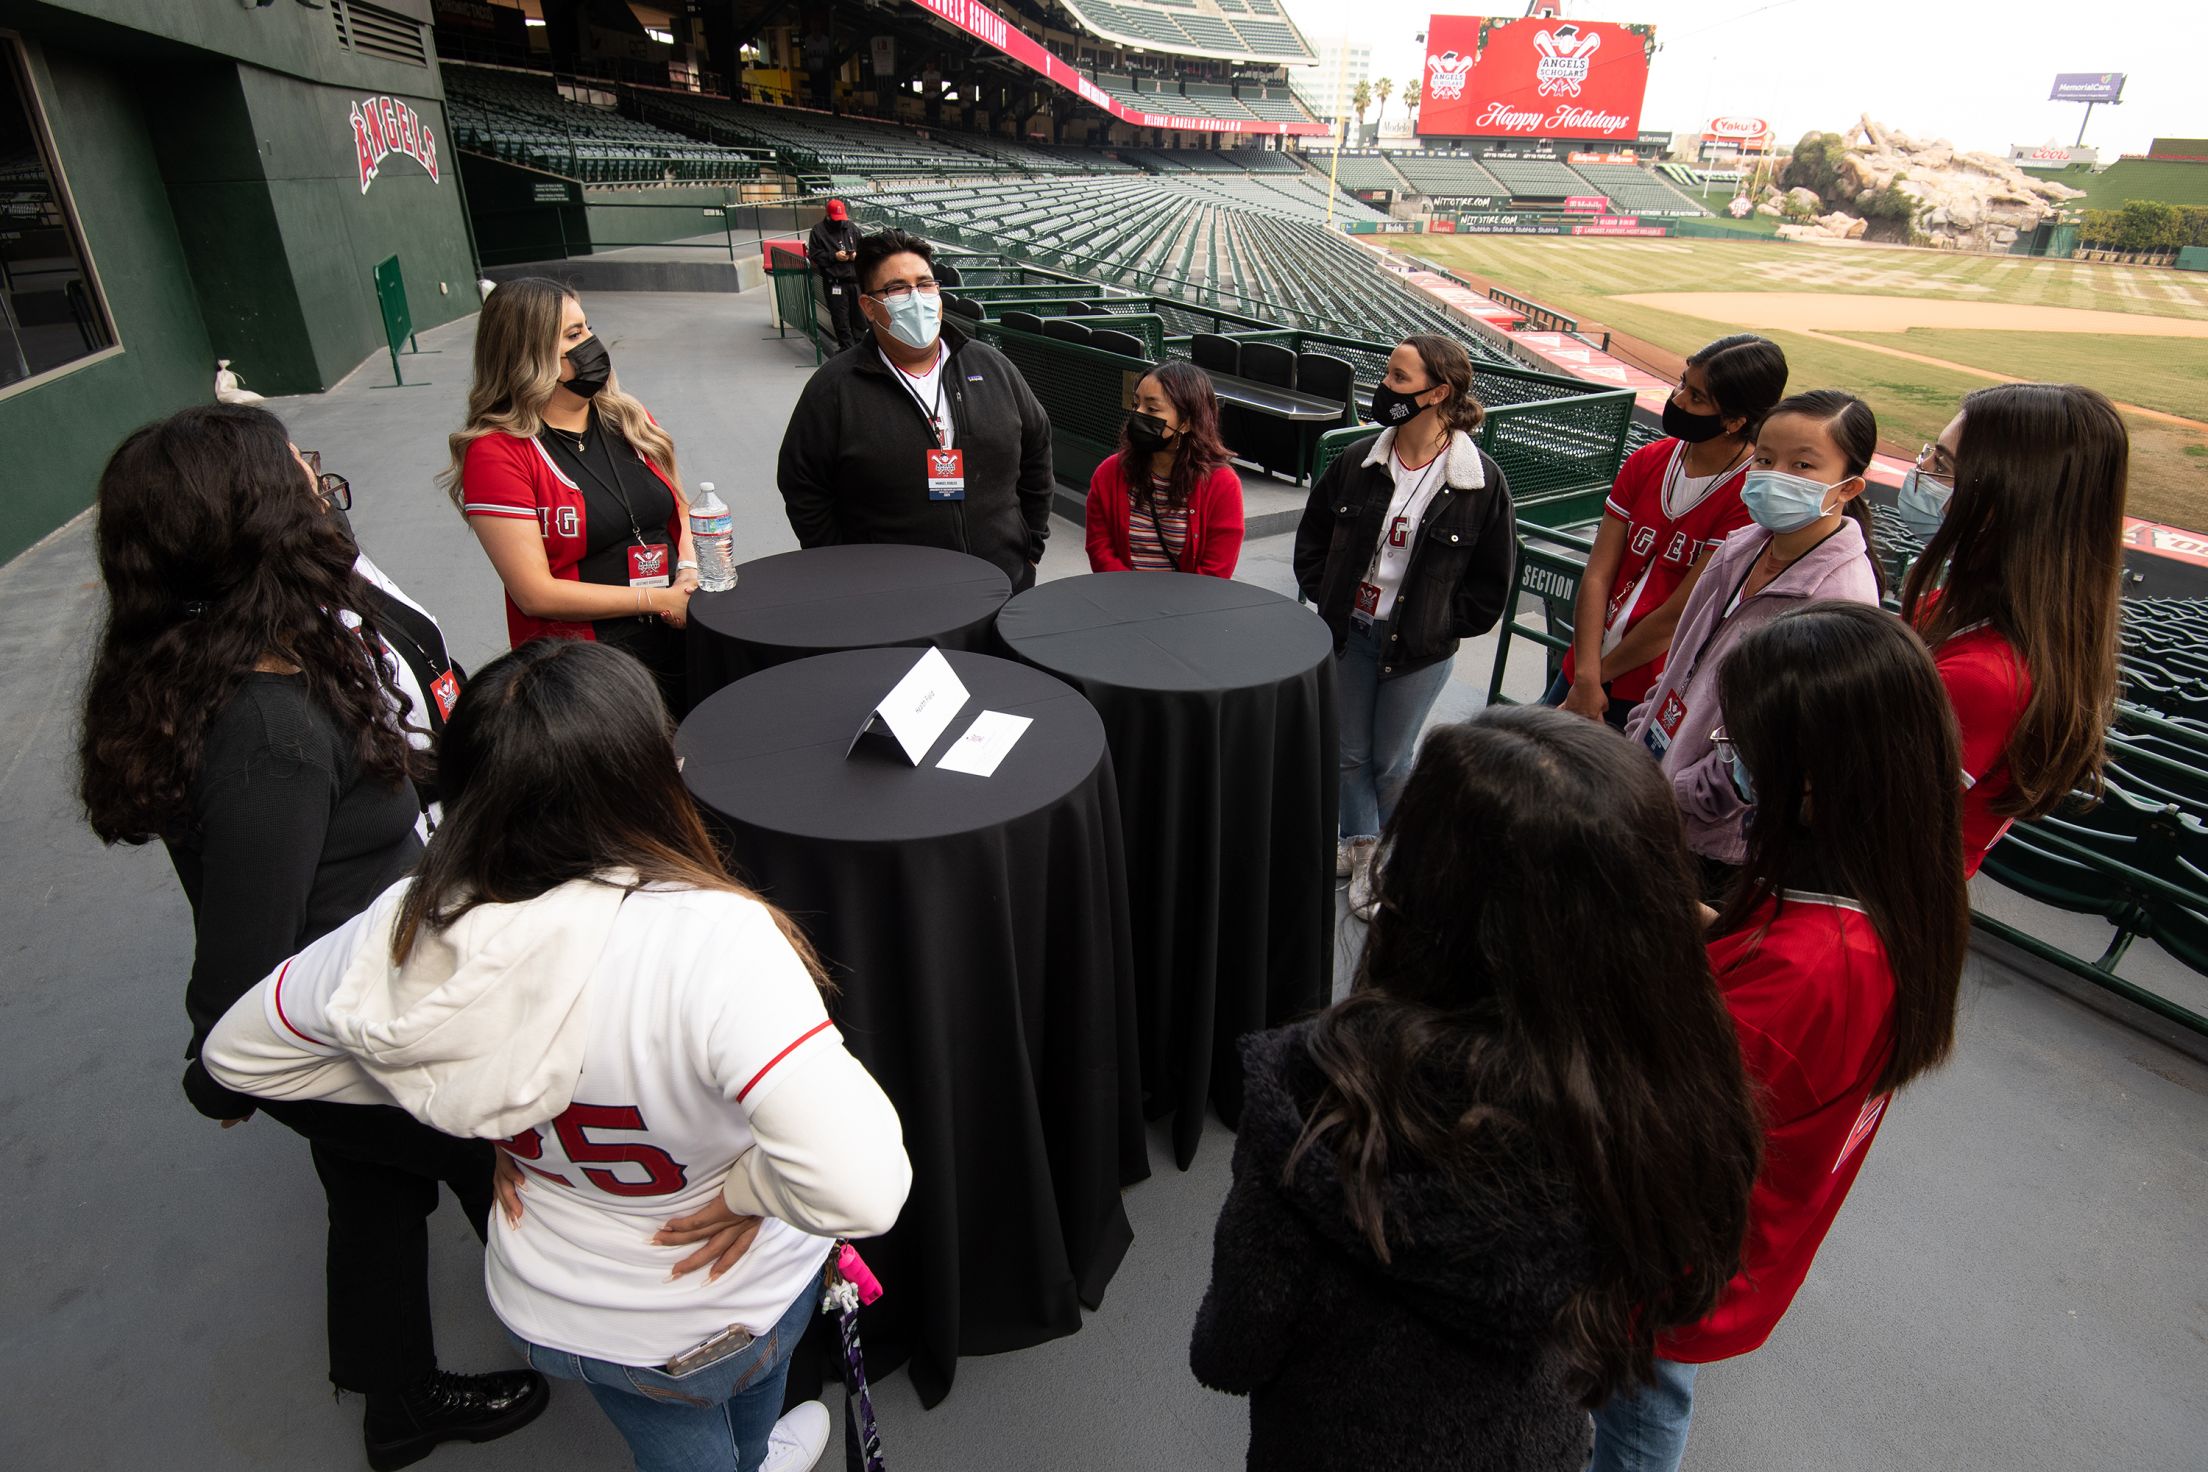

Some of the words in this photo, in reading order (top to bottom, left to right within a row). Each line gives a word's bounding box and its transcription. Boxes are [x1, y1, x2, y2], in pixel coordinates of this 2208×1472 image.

[928, 0, 966, 25] GELS
[969, 1, 1007, 49] SCHOLARS
[1543, 59, 1586, 69] ANGELS
[1540, 69, 1585, 77] SCHOLARS
[1476, 102, 1543, 132] Happy
[1545, 104, 1630, 134] Holidays
[1199, 120, 1241, 131] SCHOLARS
[1720, 121, 1758, 131] Yakut
[350, 97, 439, 195] ANGELS
[2031, 146, 2072, 160] Coors
[1392, 408, 1409, 420] 2021
[1522, 564, 1574, 600] SECTION
